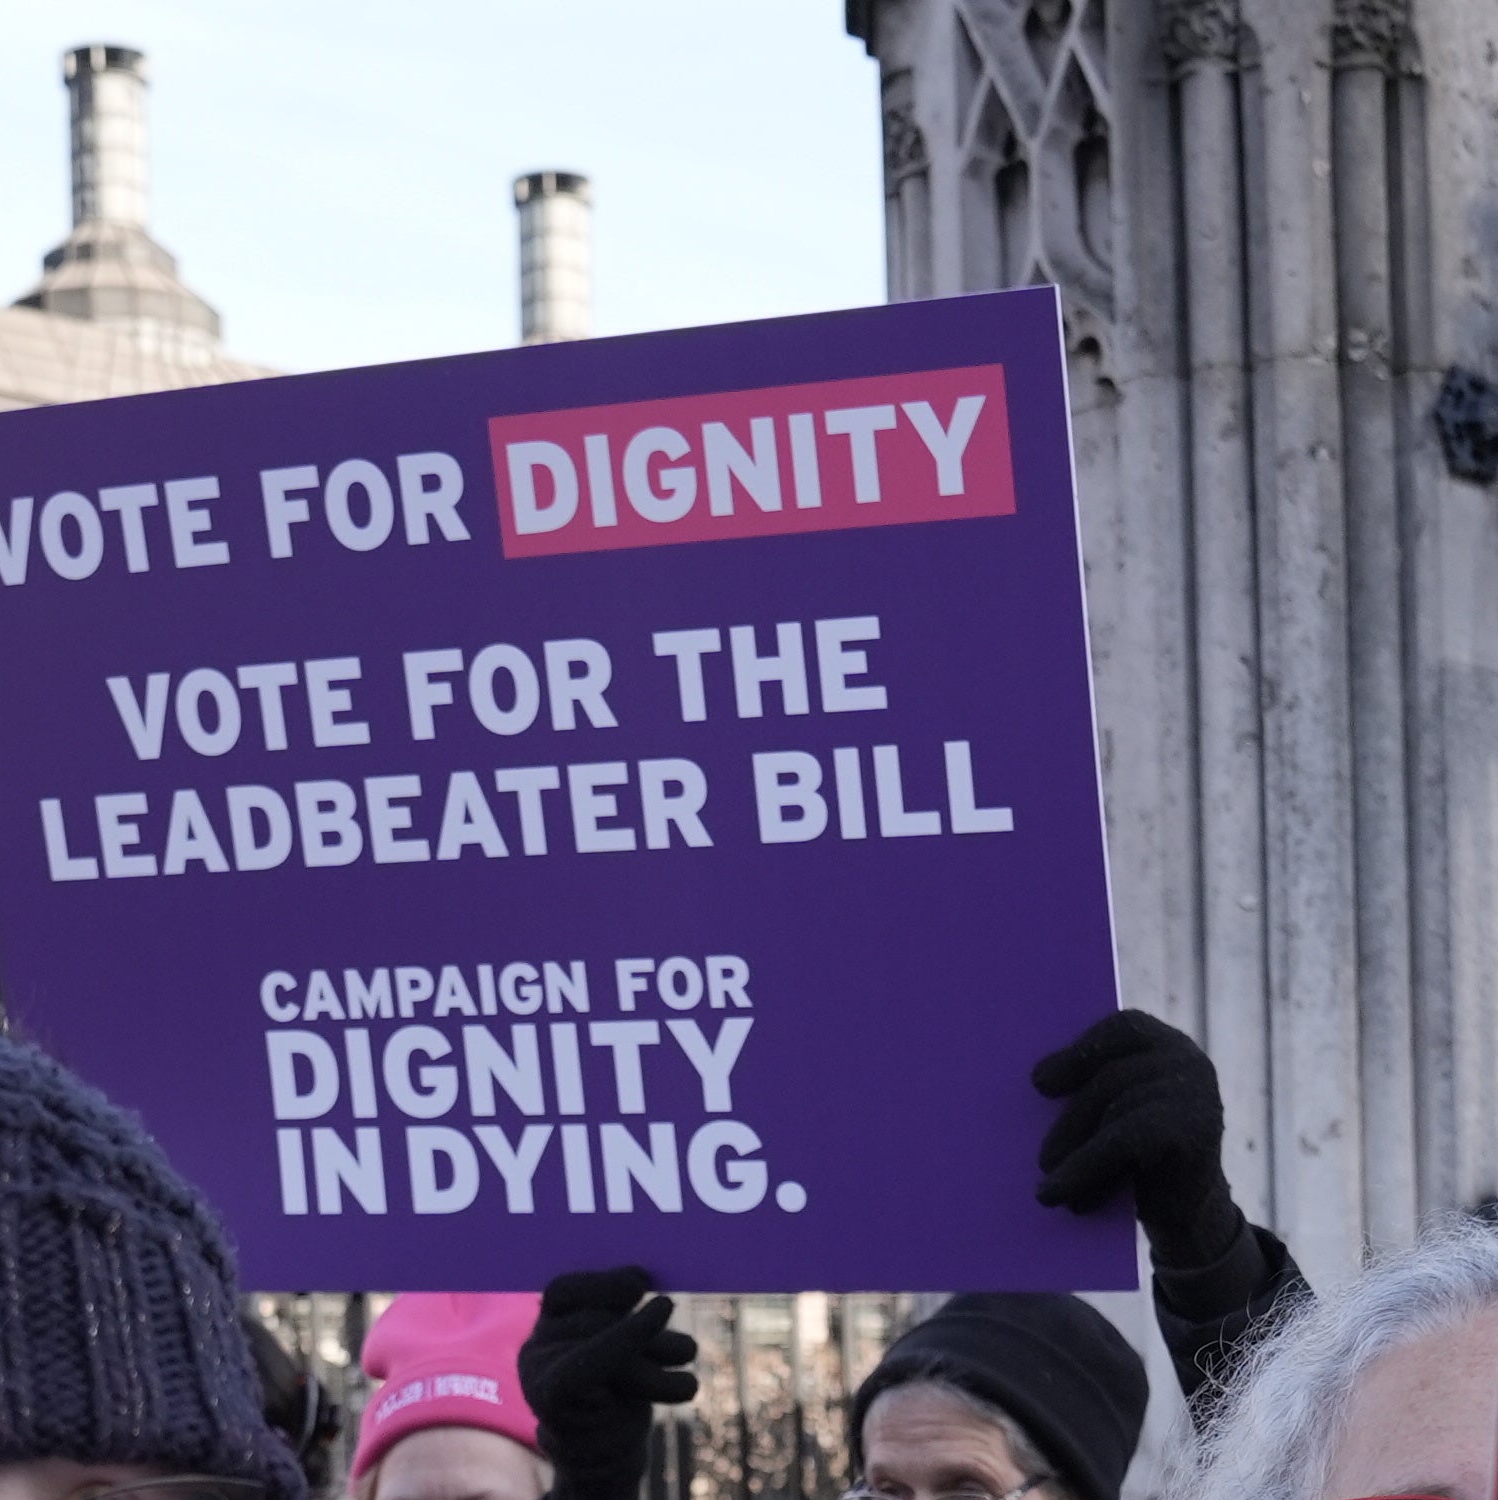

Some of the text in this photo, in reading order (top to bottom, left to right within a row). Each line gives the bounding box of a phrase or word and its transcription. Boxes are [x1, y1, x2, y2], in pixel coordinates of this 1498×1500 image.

[259, 451, 472, 560] FOR
[505, 394, 987, 536] DIGNITY
[105, 615, 889, 761] VOTE FOR THE
[39, 739, 1015, 883] LEADBEATER BILL
[259, 954, 753, 1023] CAMPAIGN FOR
[265, 1016, 755, 1121] DIGNITY
[276, 1119, 808, 1216] IN DYING.
